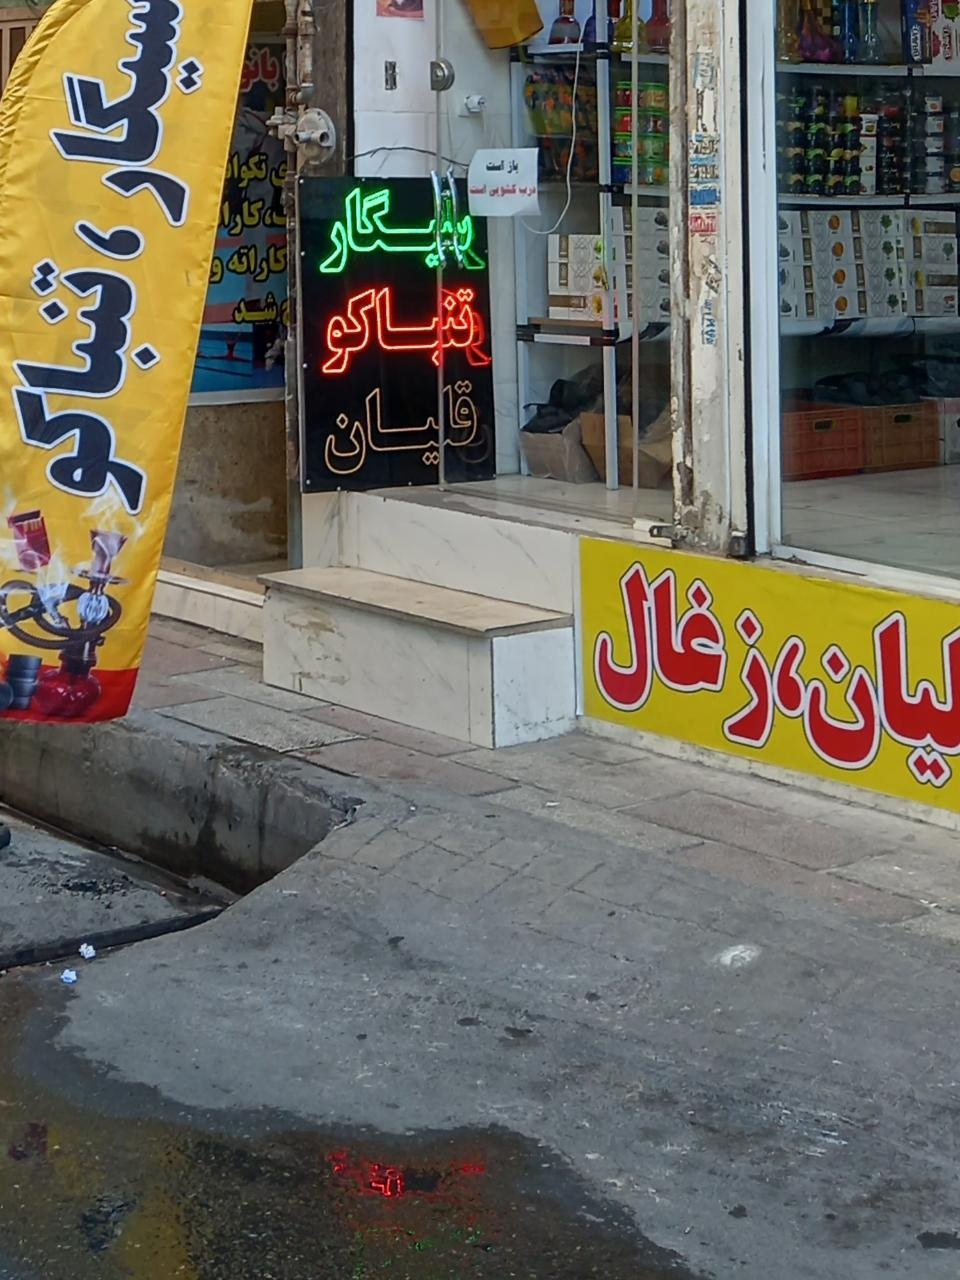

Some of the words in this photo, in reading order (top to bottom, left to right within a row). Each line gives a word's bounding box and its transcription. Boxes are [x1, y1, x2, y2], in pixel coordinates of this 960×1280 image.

[507, 160, 519, 174] باز
[319, 187, 474, 273] سیگار
[322, 287, 474, 373] تنباکو
[13, 259, 160, 515] تنباکو
[325, 380, 478, 475] قلیان
